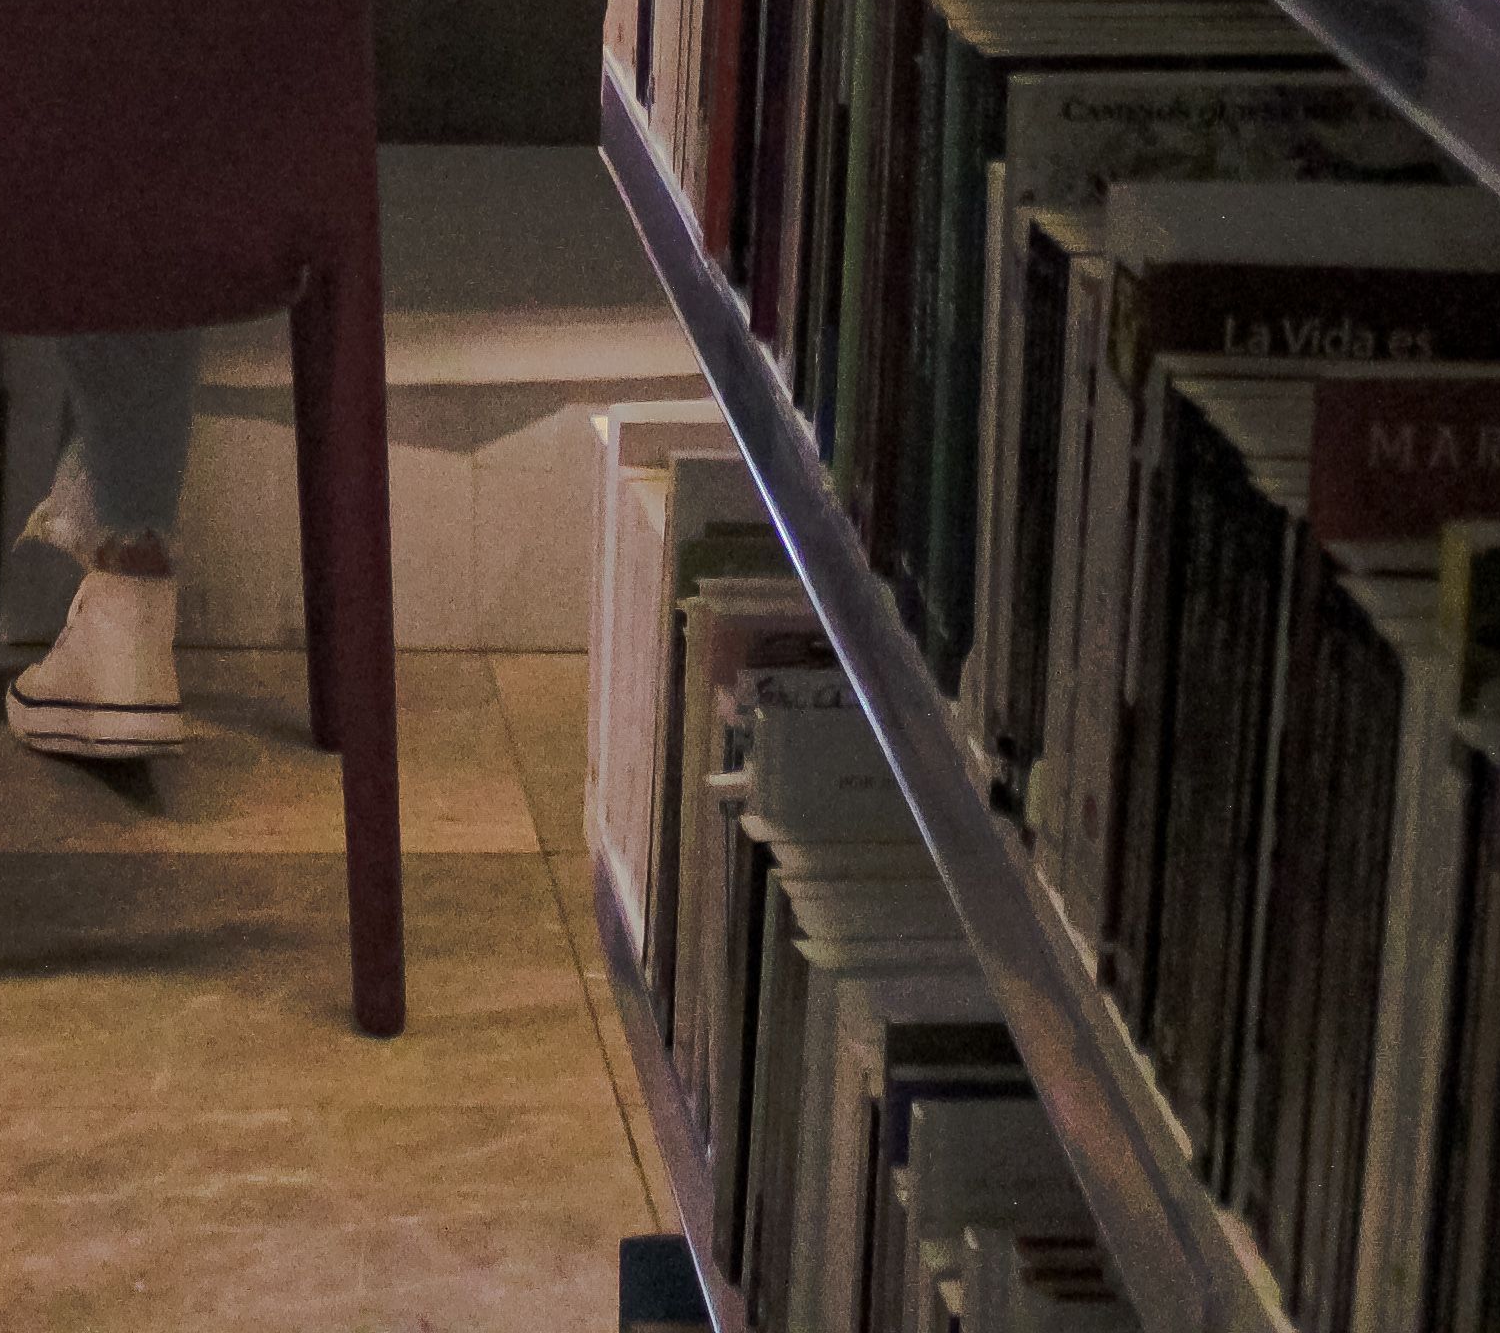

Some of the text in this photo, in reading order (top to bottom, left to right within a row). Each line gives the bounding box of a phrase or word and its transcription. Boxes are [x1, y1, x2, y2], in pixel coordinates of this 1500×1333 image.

[1223, 312, 1433, 360] La Vida es
